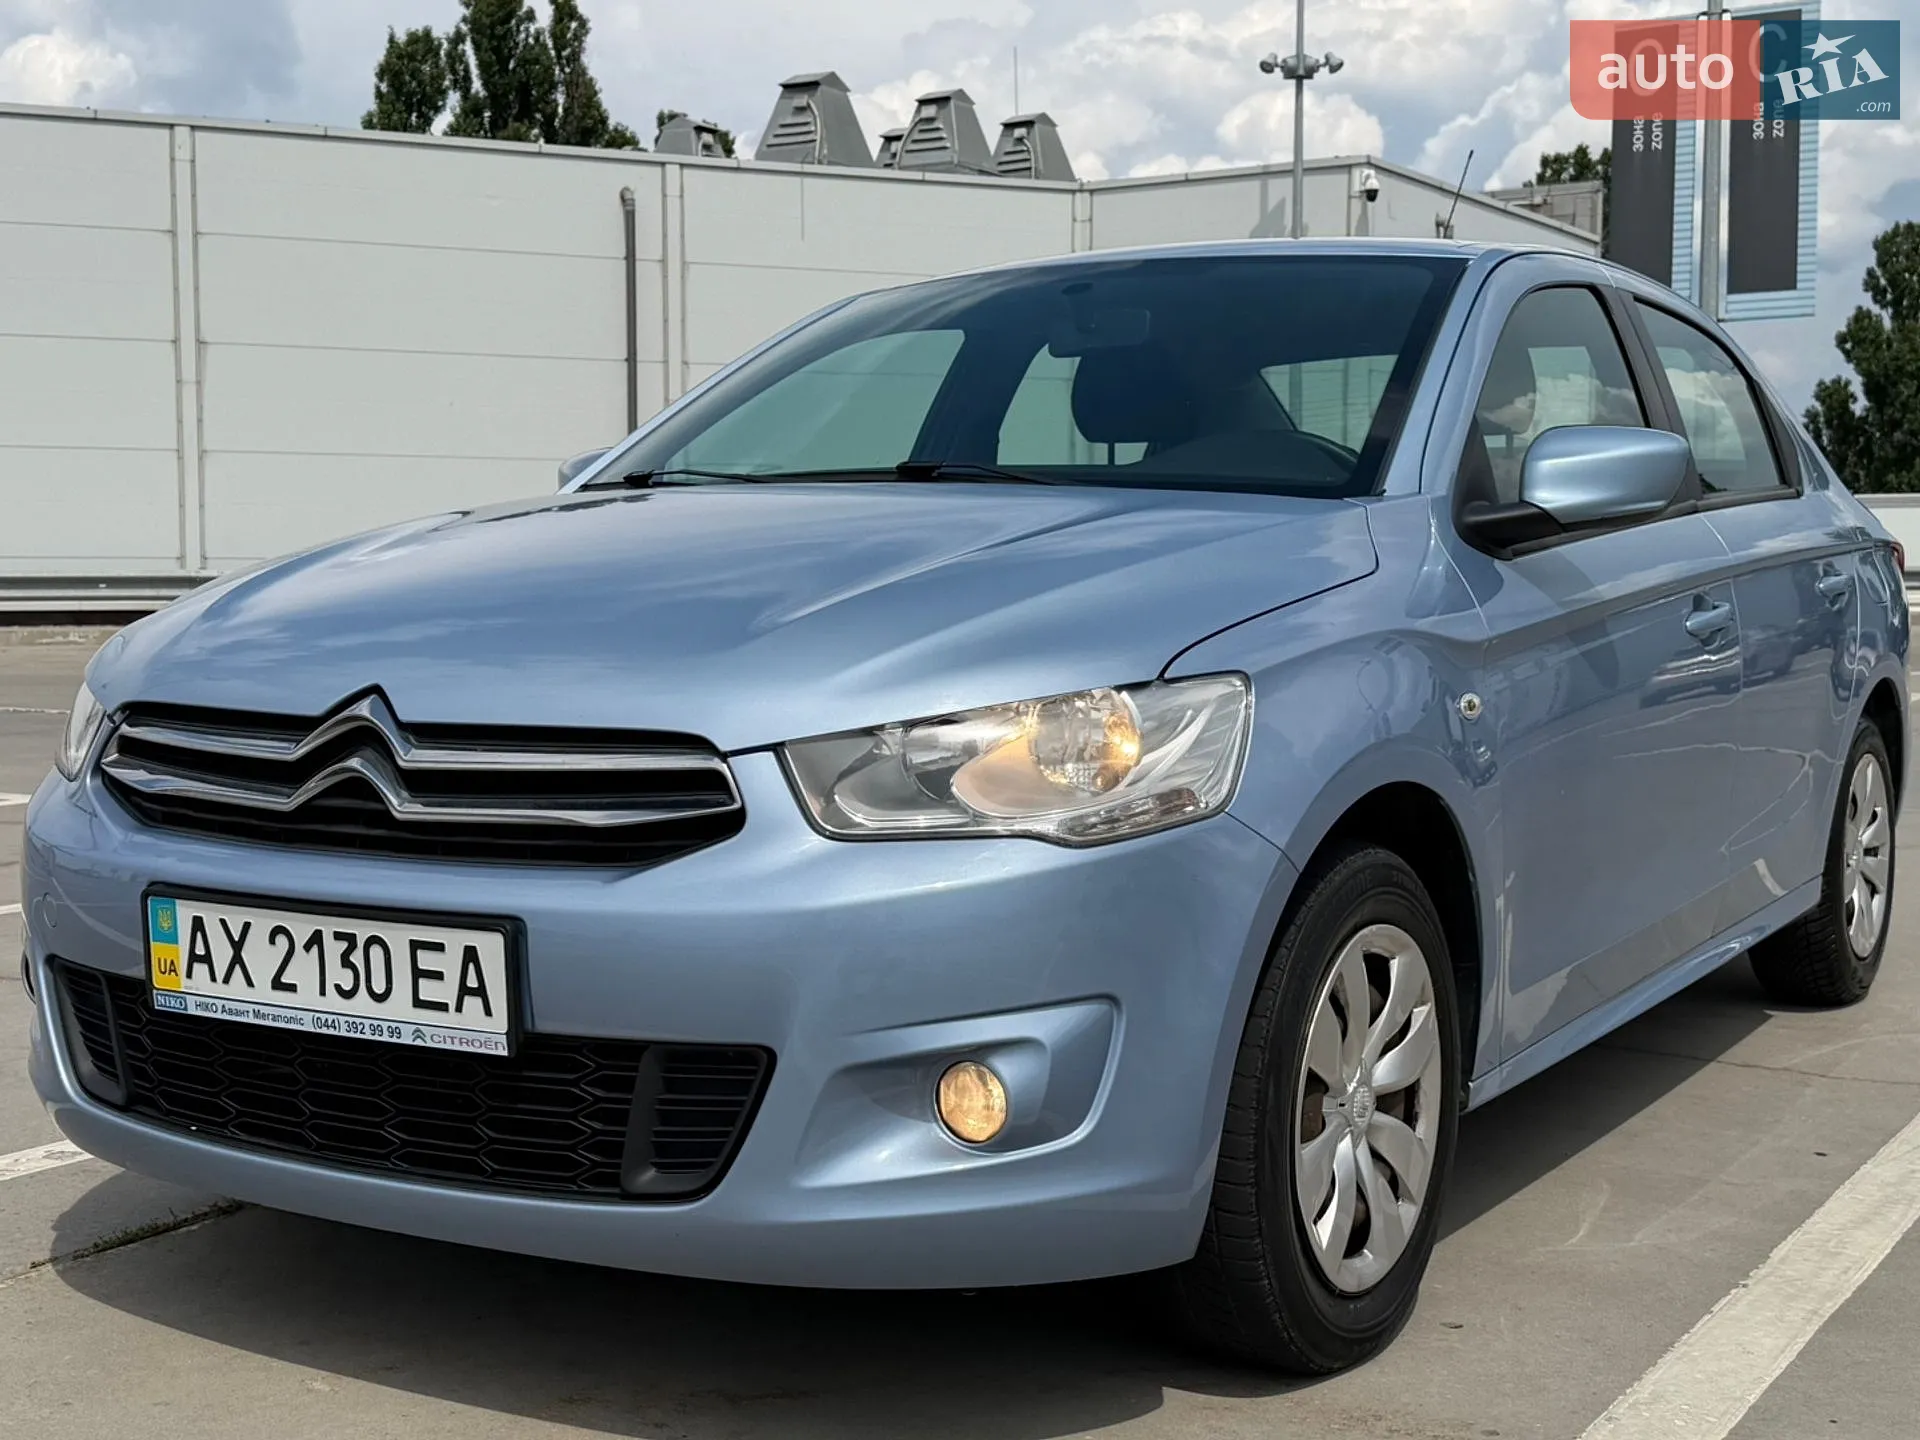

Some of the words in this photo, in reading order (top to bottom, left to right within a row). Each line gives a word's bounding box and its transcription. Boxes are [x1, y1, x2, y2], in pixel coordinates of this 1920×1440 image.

[1651, 111, 1664, 151] zone
[1772, 99, 1785, 139] zone
[157, 956, 179, 978] UA
[185, 914, 256, 989] AX
[267, 923, 393, 1004] 2130
[408, 937, 494, 1018] EA
[156, 993, 186, 1010] NIKO
[221, 1004, 250, 1018] Авант
[312, 1014, 341, 1033] (044)
[344, 1019, 366, 1035] 392
[369, 1023, 384, 1037] 99
[387, 1026, 402, 1039] 99
